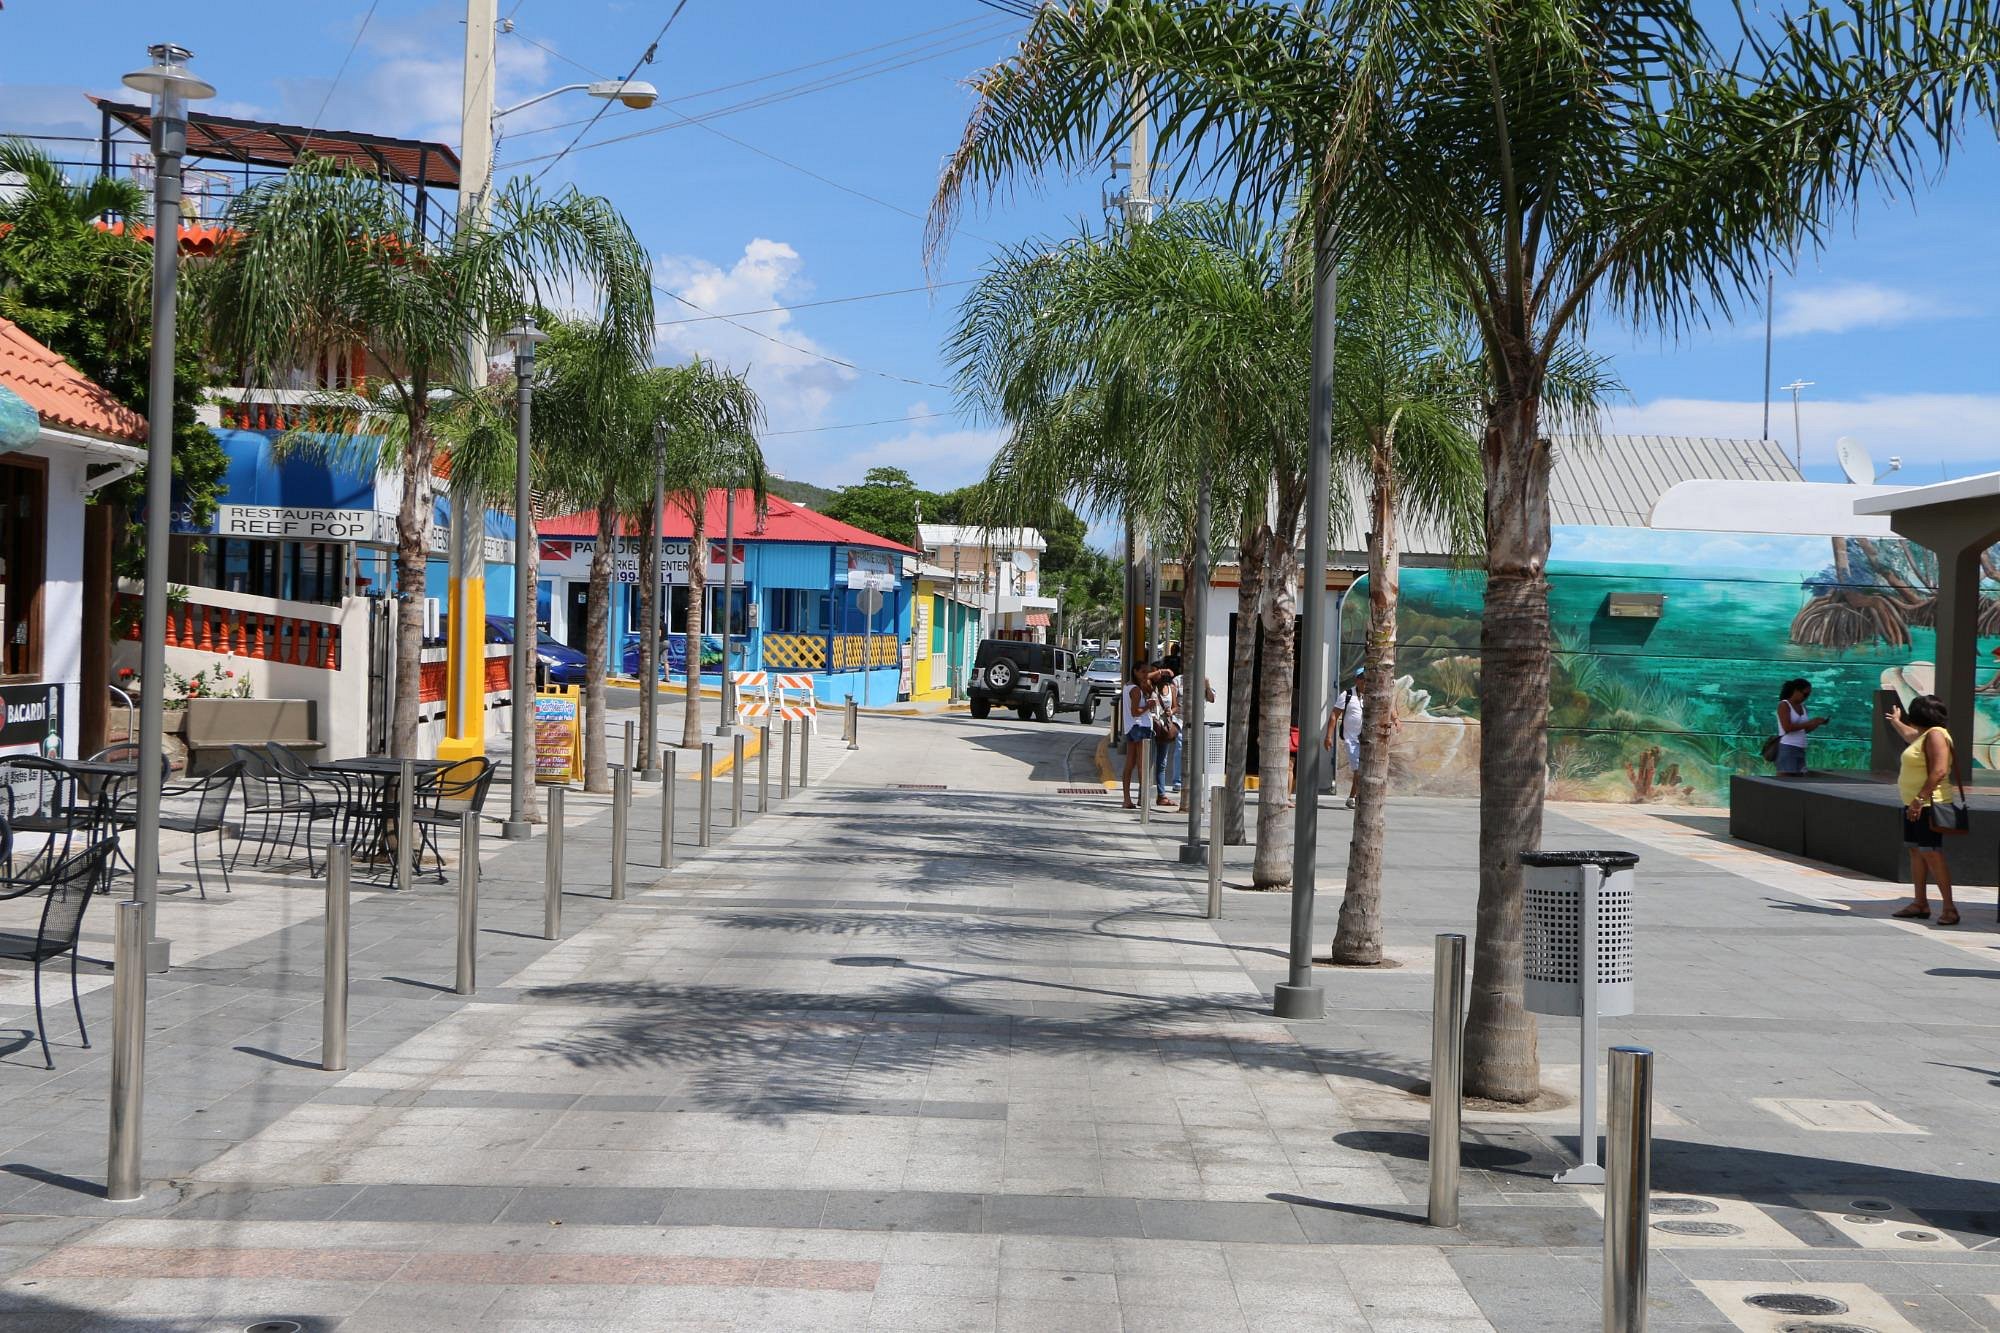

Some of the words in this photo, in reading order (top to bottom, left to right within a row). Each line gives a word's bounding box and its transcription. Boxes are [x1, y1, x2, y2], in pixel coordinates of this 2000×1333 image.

[231, 507, 365, 522] RESTAURANT
[230, 519, 299, 534] REEF
[311, 523, 365, 537] POP
[661, 560, 689, 571] ENTER
[7, 696, 46, 724] BACARDÍ
